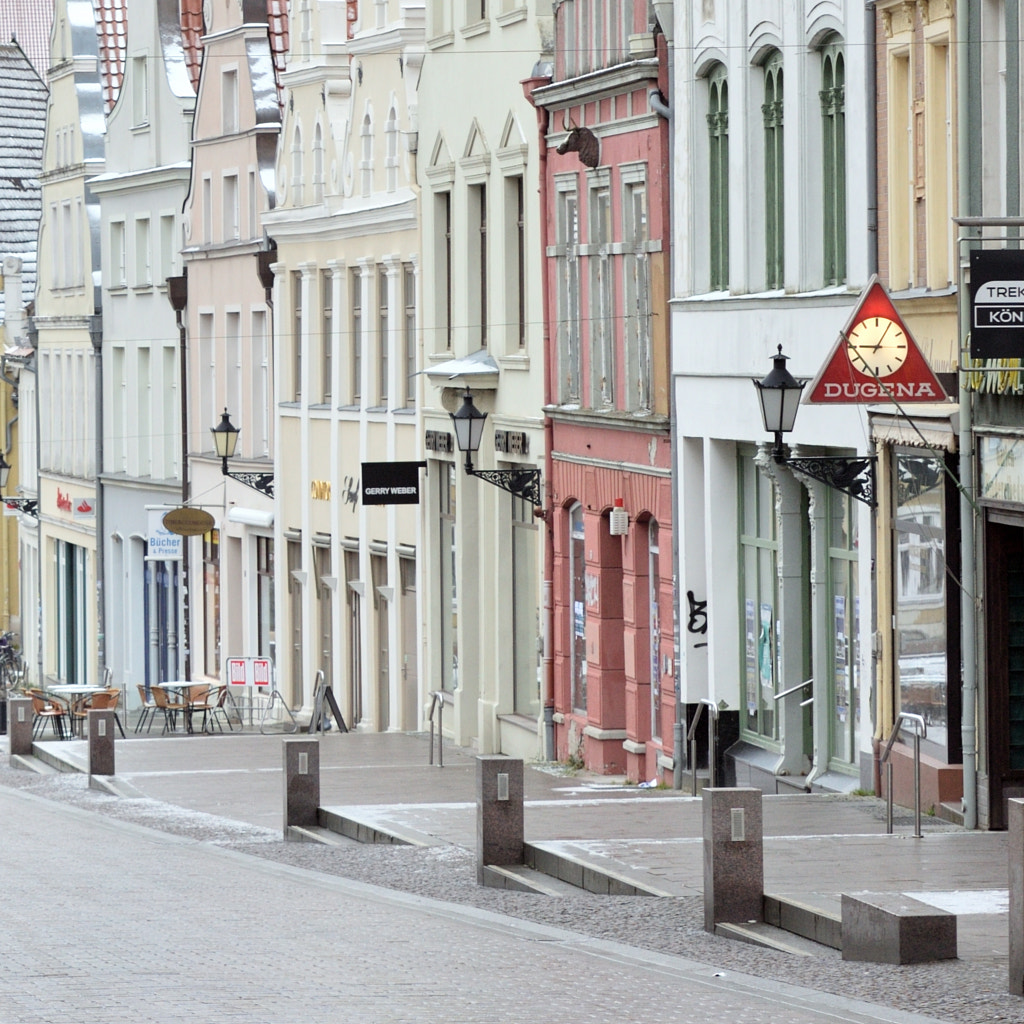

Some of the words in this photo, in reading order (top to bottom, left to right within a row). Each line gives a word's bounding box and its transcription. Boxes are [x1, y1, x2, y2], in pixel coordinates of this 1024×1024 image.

[824, 382, 936, 397] DUGENA
[365, 487, 390, 495] GERRY
[390, 486, 417, 495] WEBER
[150, 537, 181, 547] Bücher
